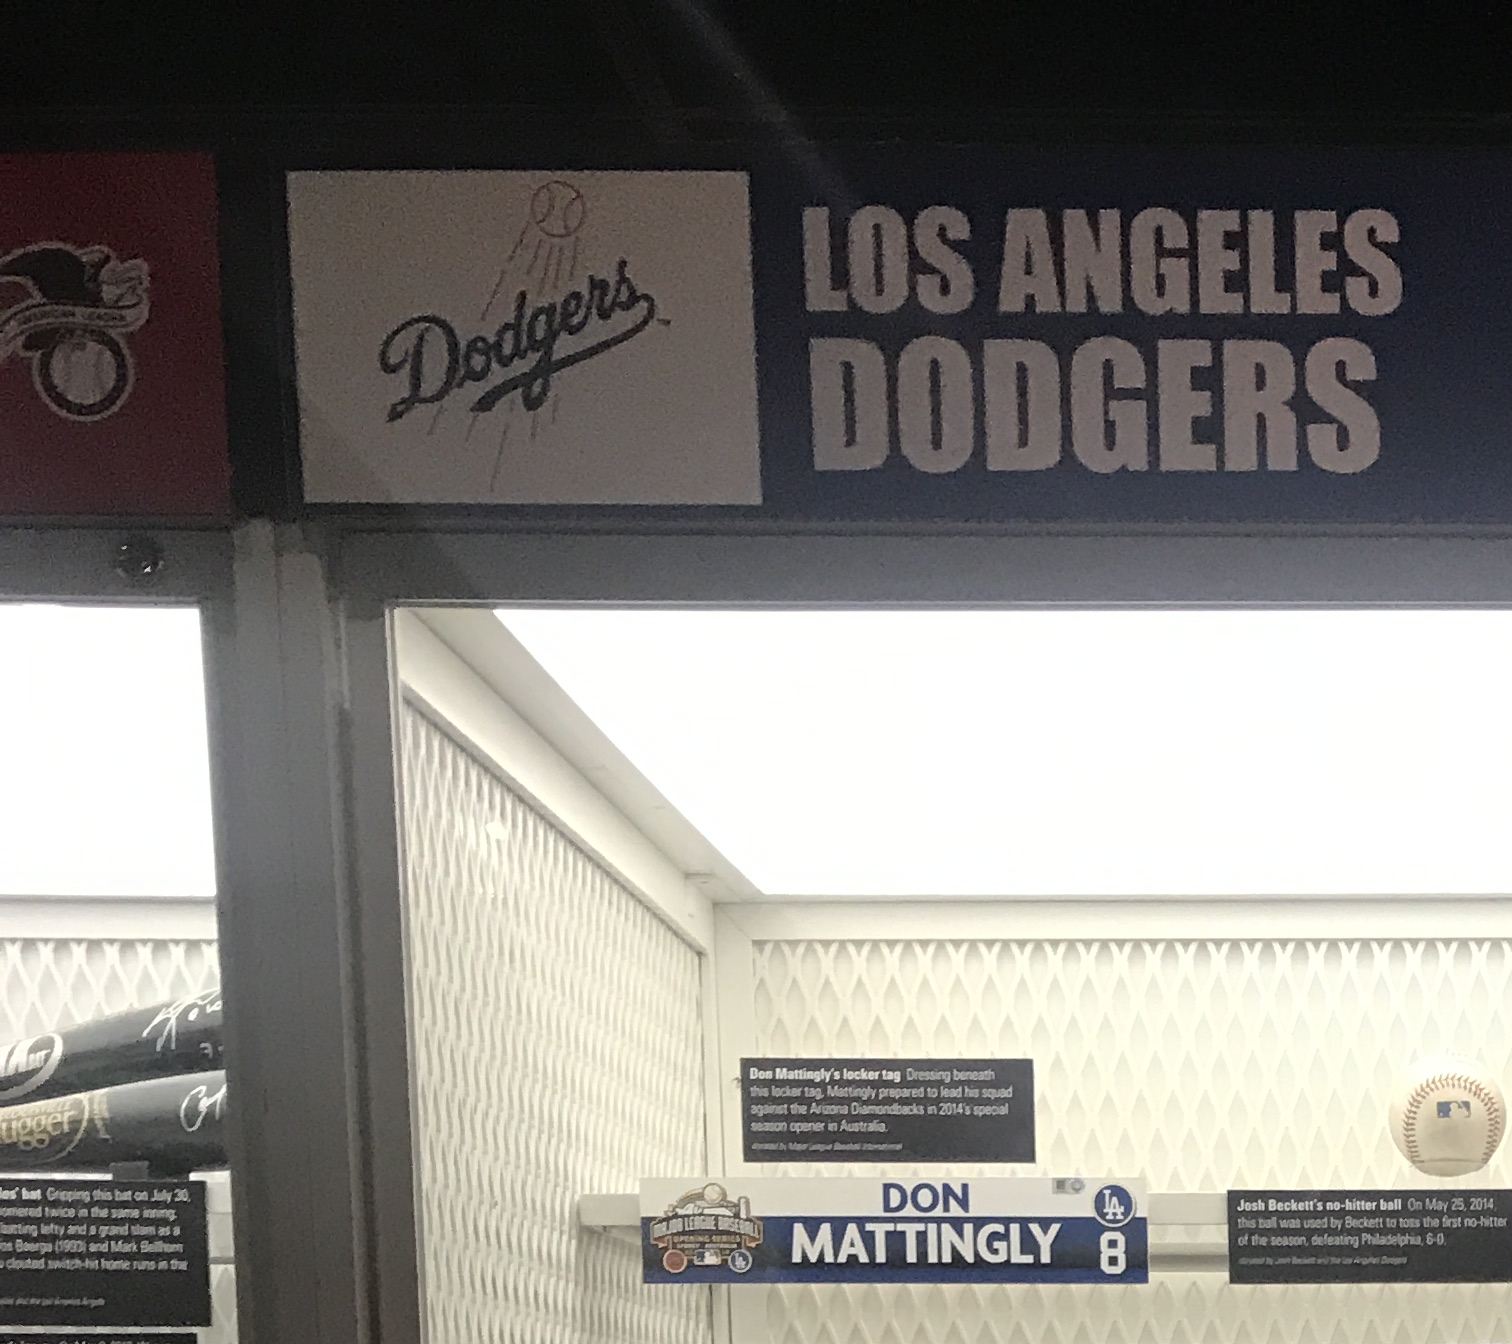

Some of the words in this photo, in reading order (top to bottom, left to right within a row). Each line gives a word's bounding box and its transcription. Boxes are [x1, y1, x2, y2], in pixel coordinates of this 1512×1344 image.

[803, 206, 975, 314] LOS
[1000, 207, 1404, 316] ANGELES
[380, 259, 657, 422] Dodgers
[809, 335, 1381, 474] DODGERS
[750, 1068, 772, 1079] Don
[776, 1068, 840, 1082] Mattingly's
[843, 1068, 880, 1080] locker
[882, 1070, 900, 1082] tag
[882, 1183, 969, 1213] DON
[1237, 1199, 1265, 1211] Josh
[1269, 1199, 1323, 1211] Beckett's
[1326, 1199, 1377, 1210] no-hitter
[1380, 1199, 1401, 1210] ball
[792, 1222, 1061, 1264] MATTINGLY
[1100, 1232, 1126, 1275] 8
